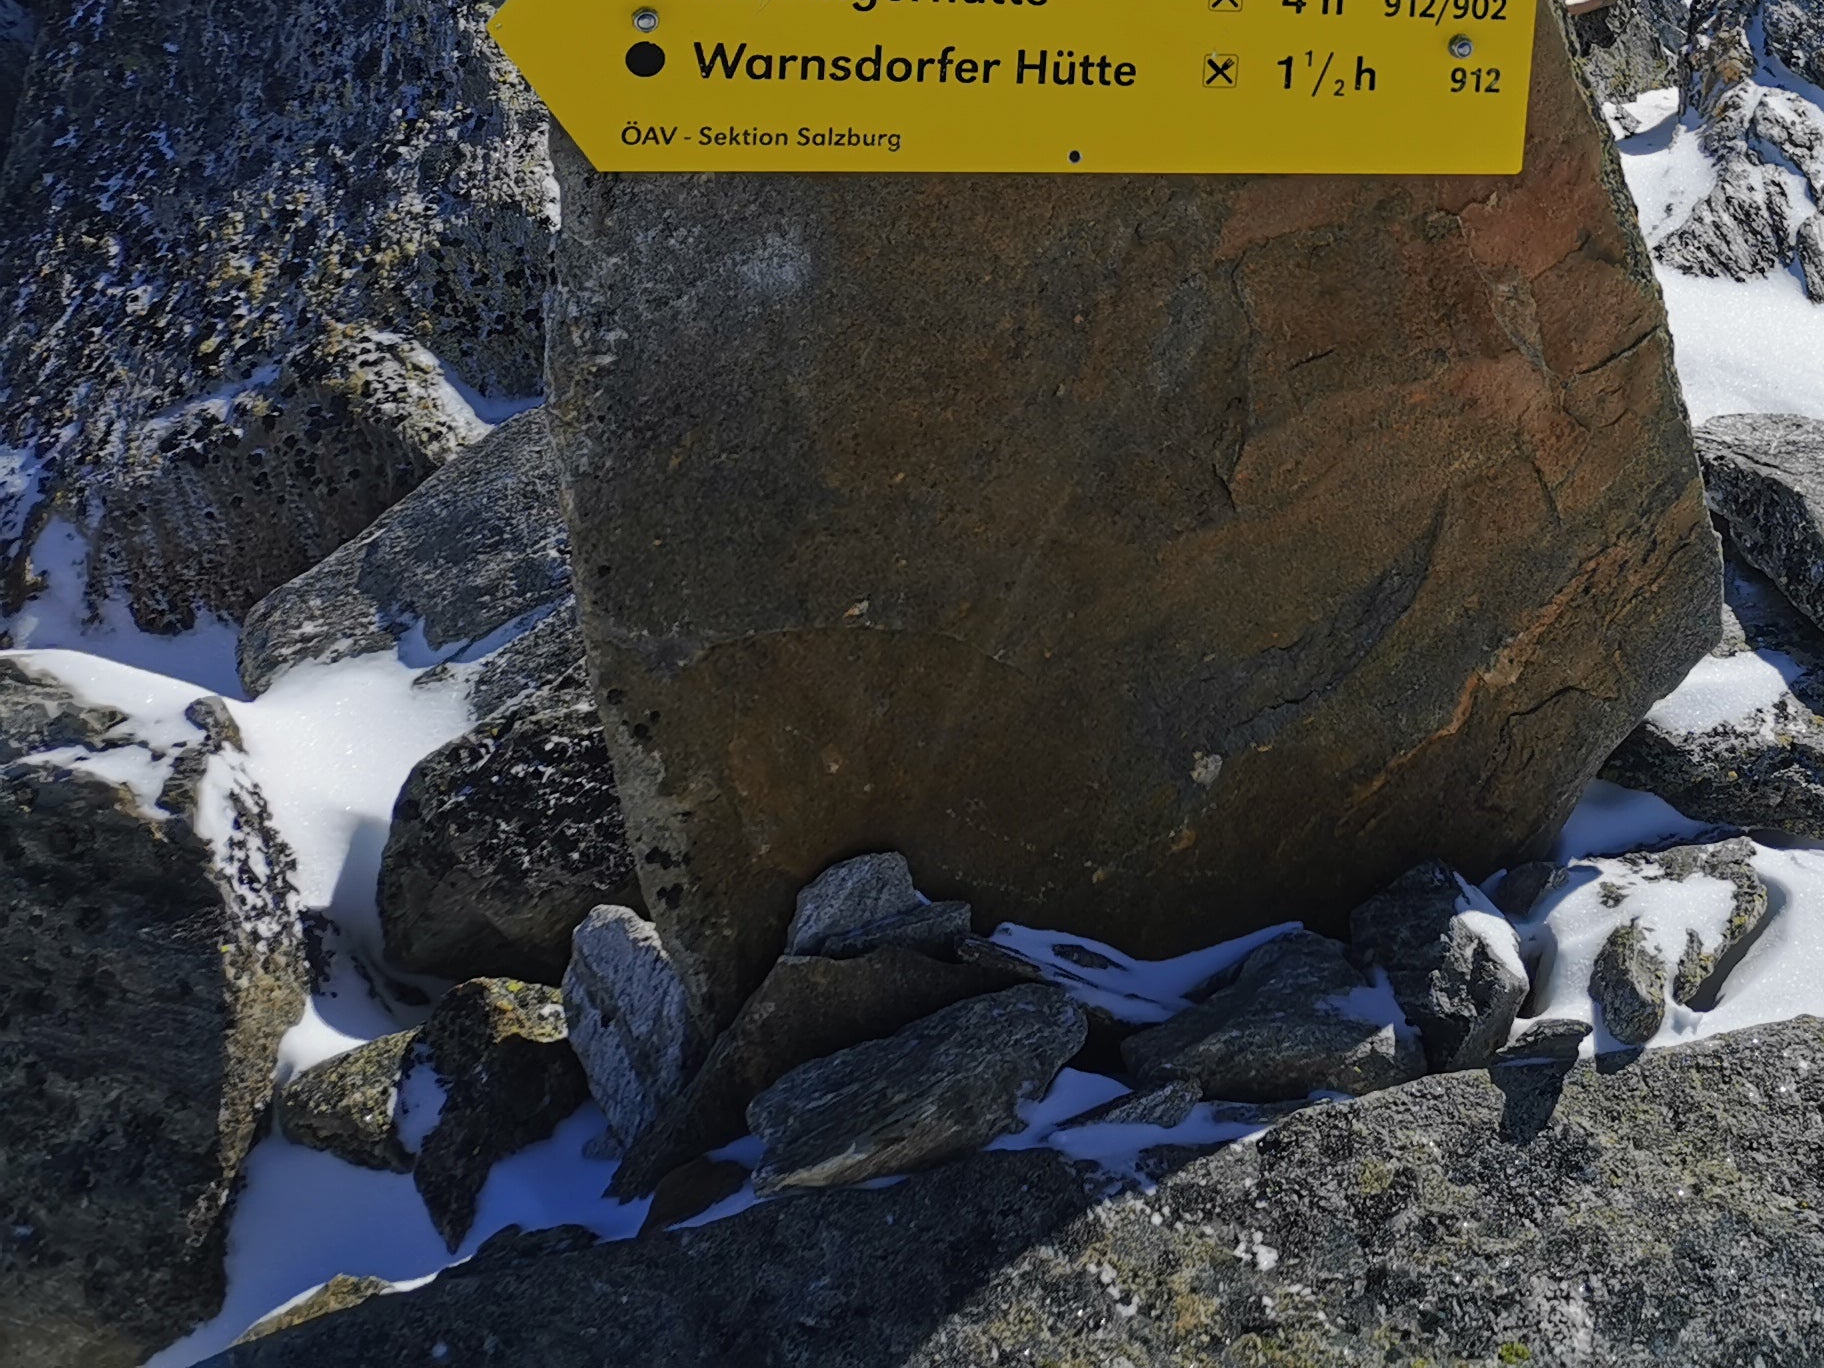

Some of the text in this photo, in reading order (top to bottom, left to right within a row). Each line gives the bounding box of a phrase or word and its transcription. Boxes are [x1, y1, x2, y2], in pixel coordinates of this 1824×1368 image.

[693, 41, 1001, 84] Warnsdorfer
[1016, 49, 1137, 87] Hütte
[1450, 67, 1501, 94] 912
[620, 121, 678, 147] ÖAV
[698, 126, 788, 146] Sektion
[796, 127, 901, 153] Salzburg
